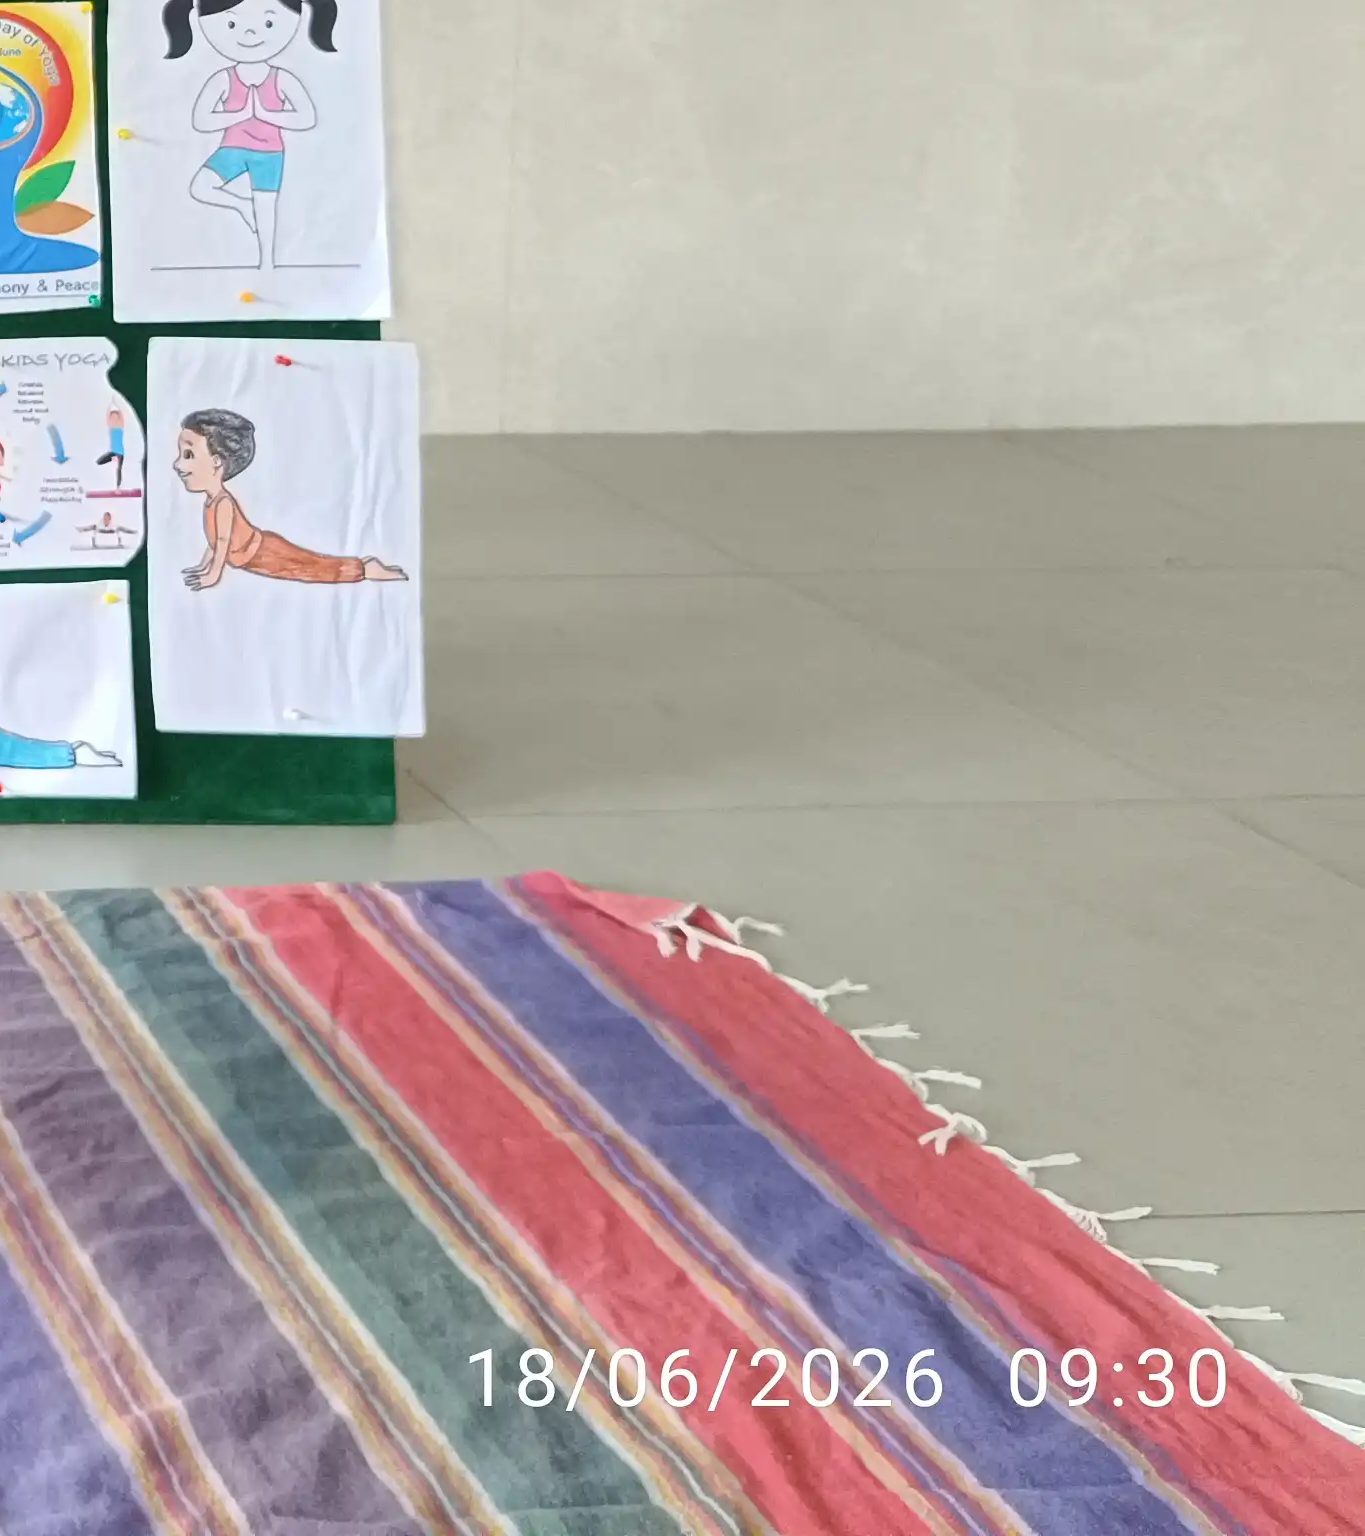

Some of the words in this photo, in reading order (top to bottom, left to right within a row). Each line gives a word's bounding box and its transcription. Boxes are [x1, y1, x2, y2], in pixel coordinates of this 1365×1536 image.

[23, 34, 39, 47] of
[37, 279, 48, 292] &
[55, 278, 99, 292] Peace
[1, 353, 49, 368] KIDS
[54, 352, 110, 371] YOGA
